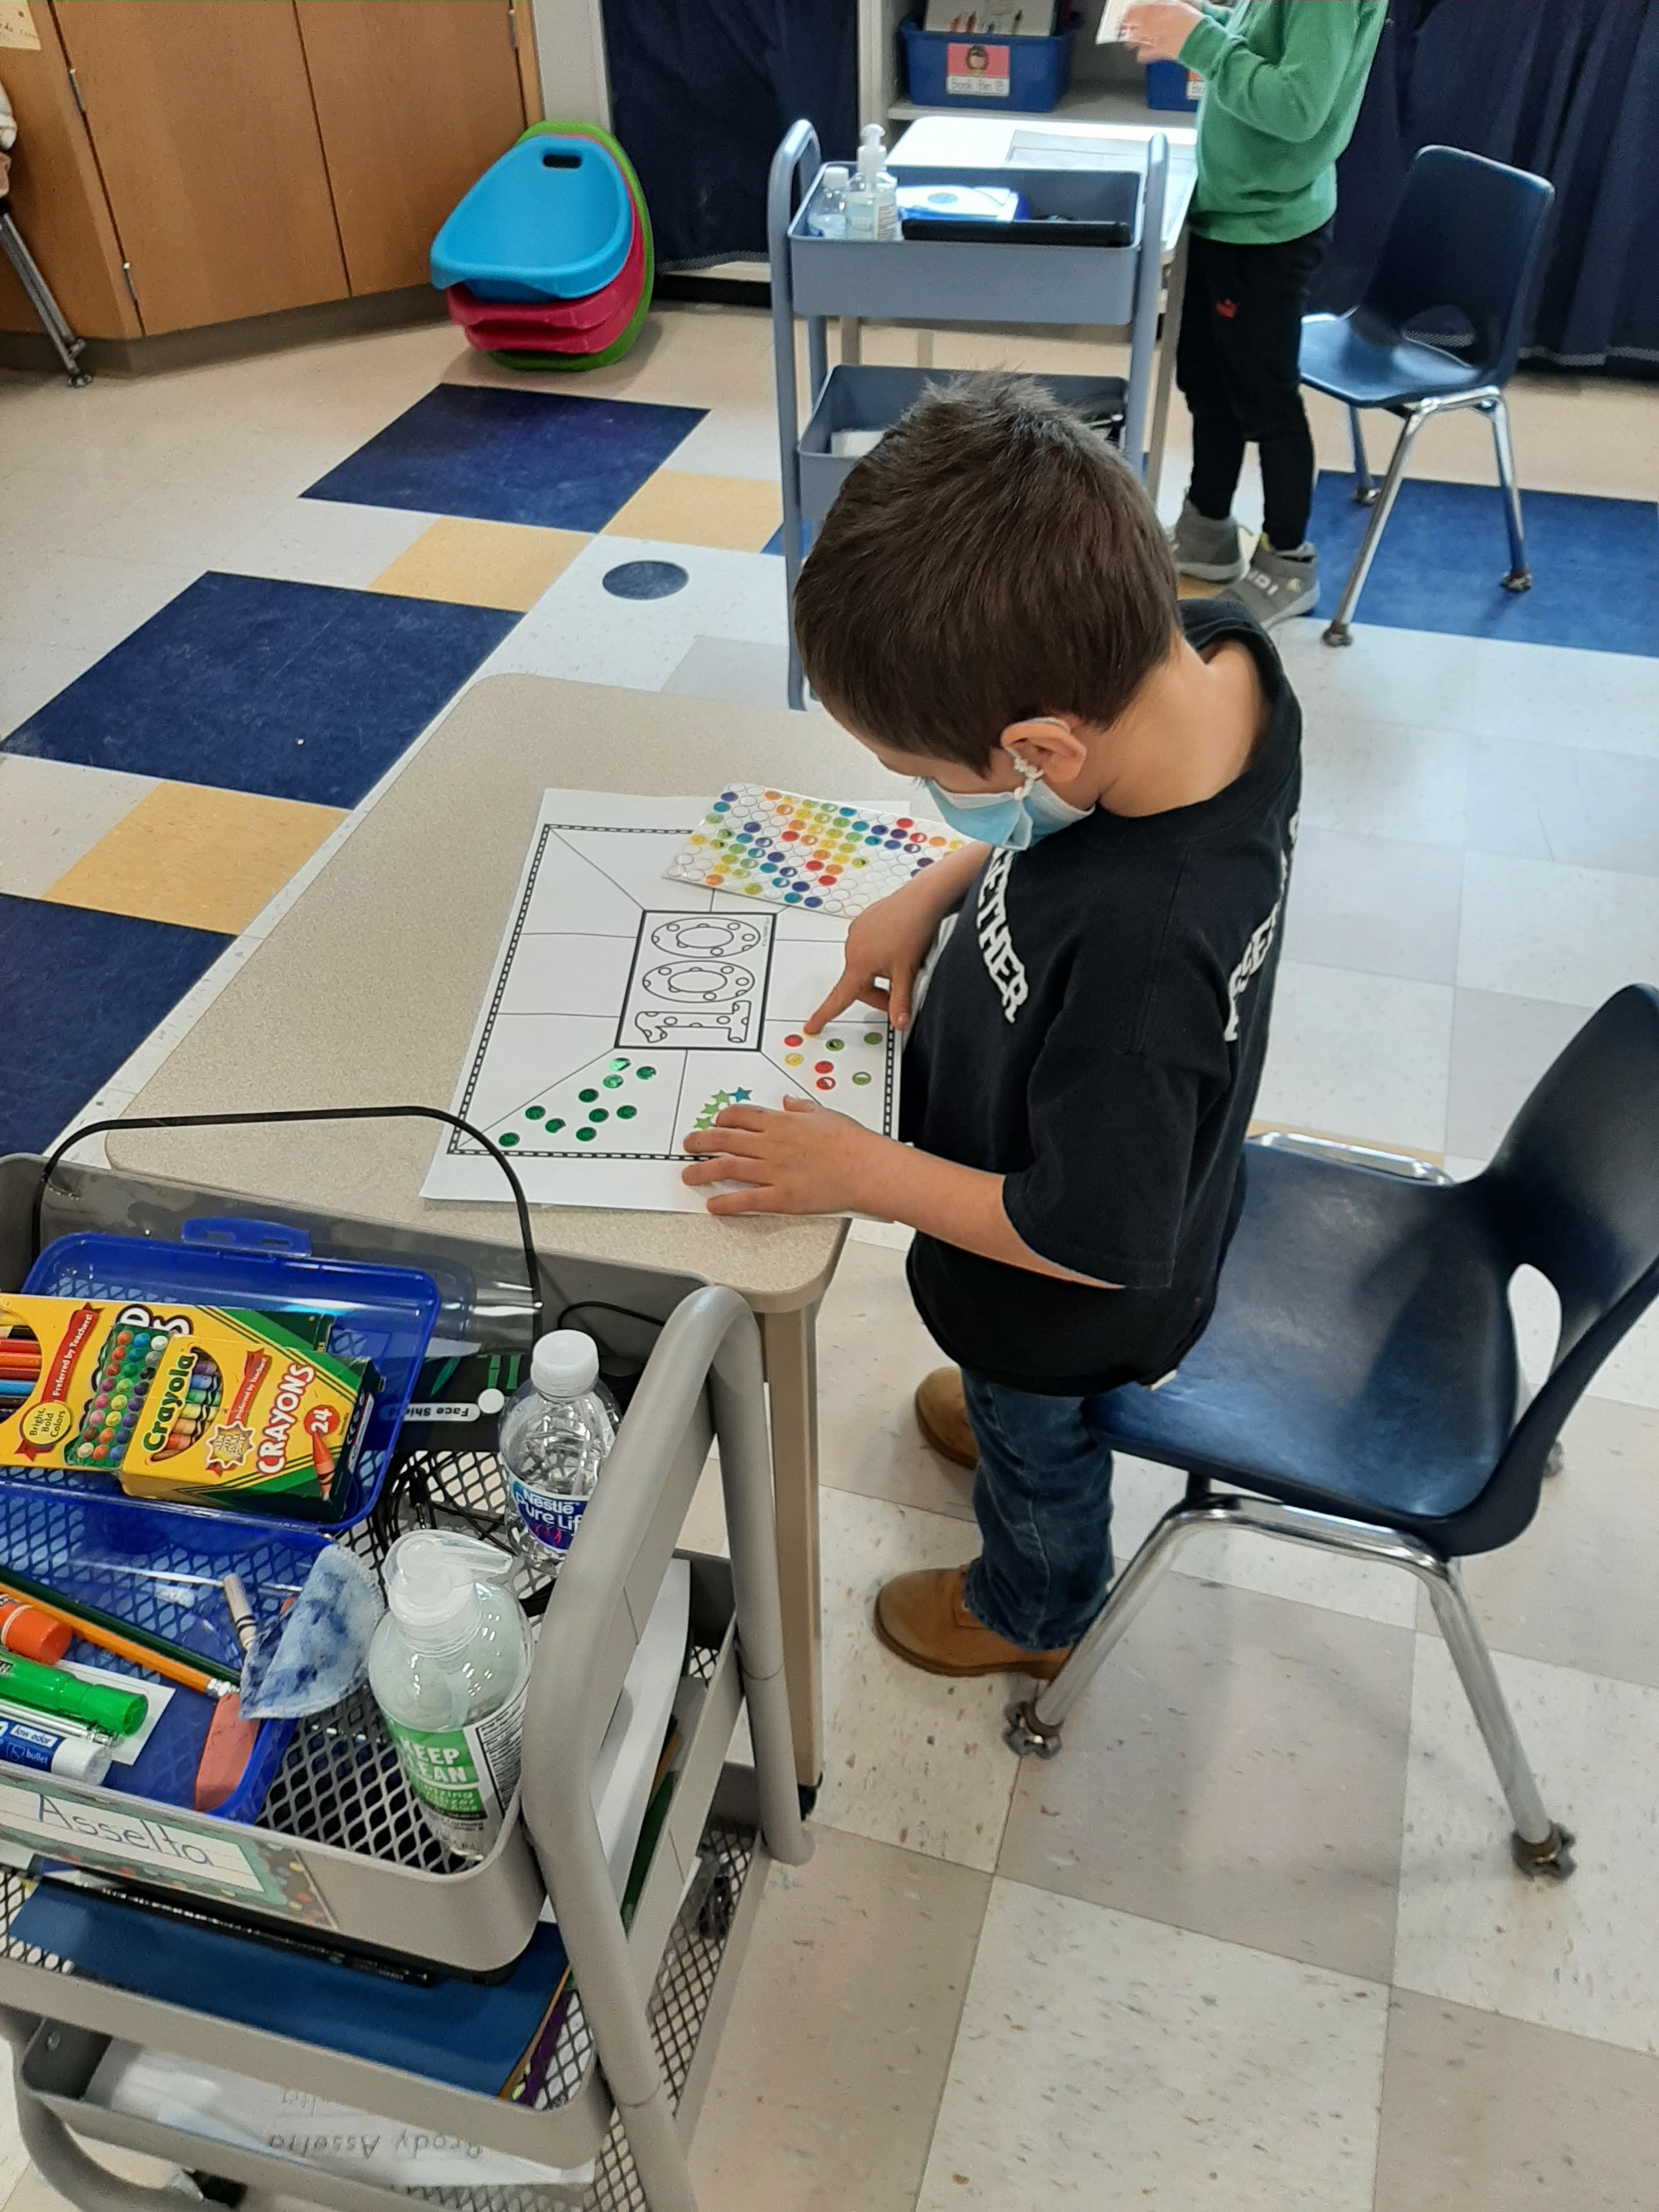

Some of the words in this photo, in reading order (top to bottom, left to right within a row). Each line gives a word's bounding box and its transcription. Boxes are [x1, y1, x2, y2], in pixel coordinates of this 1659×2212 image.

[977, 848, 1029, 1023] GETHER
[635, 917, 761, 1043] 100
[52, 1359, 70, 1397] Preferred
[64, 1348, 75, 1359] by
[30, 1407, 46, 1436] Bright,
[143, 1355, 195, 1451] Crayola
[258, 1363, 315, 1475] CRAYONS
[311, 1408, 332, 1433] 24
[436, 1407, 469, 1417] Face
[41, 1412, 54, 1432] Bold
[50, 1410, 66, 1437] Colors
[516, 1491, 555, 1525] Pure
[558, 1514, 584, 1536] Lif
[15, 1726, 31, 1737] low
[31, 1734, 52, 1743] odor
